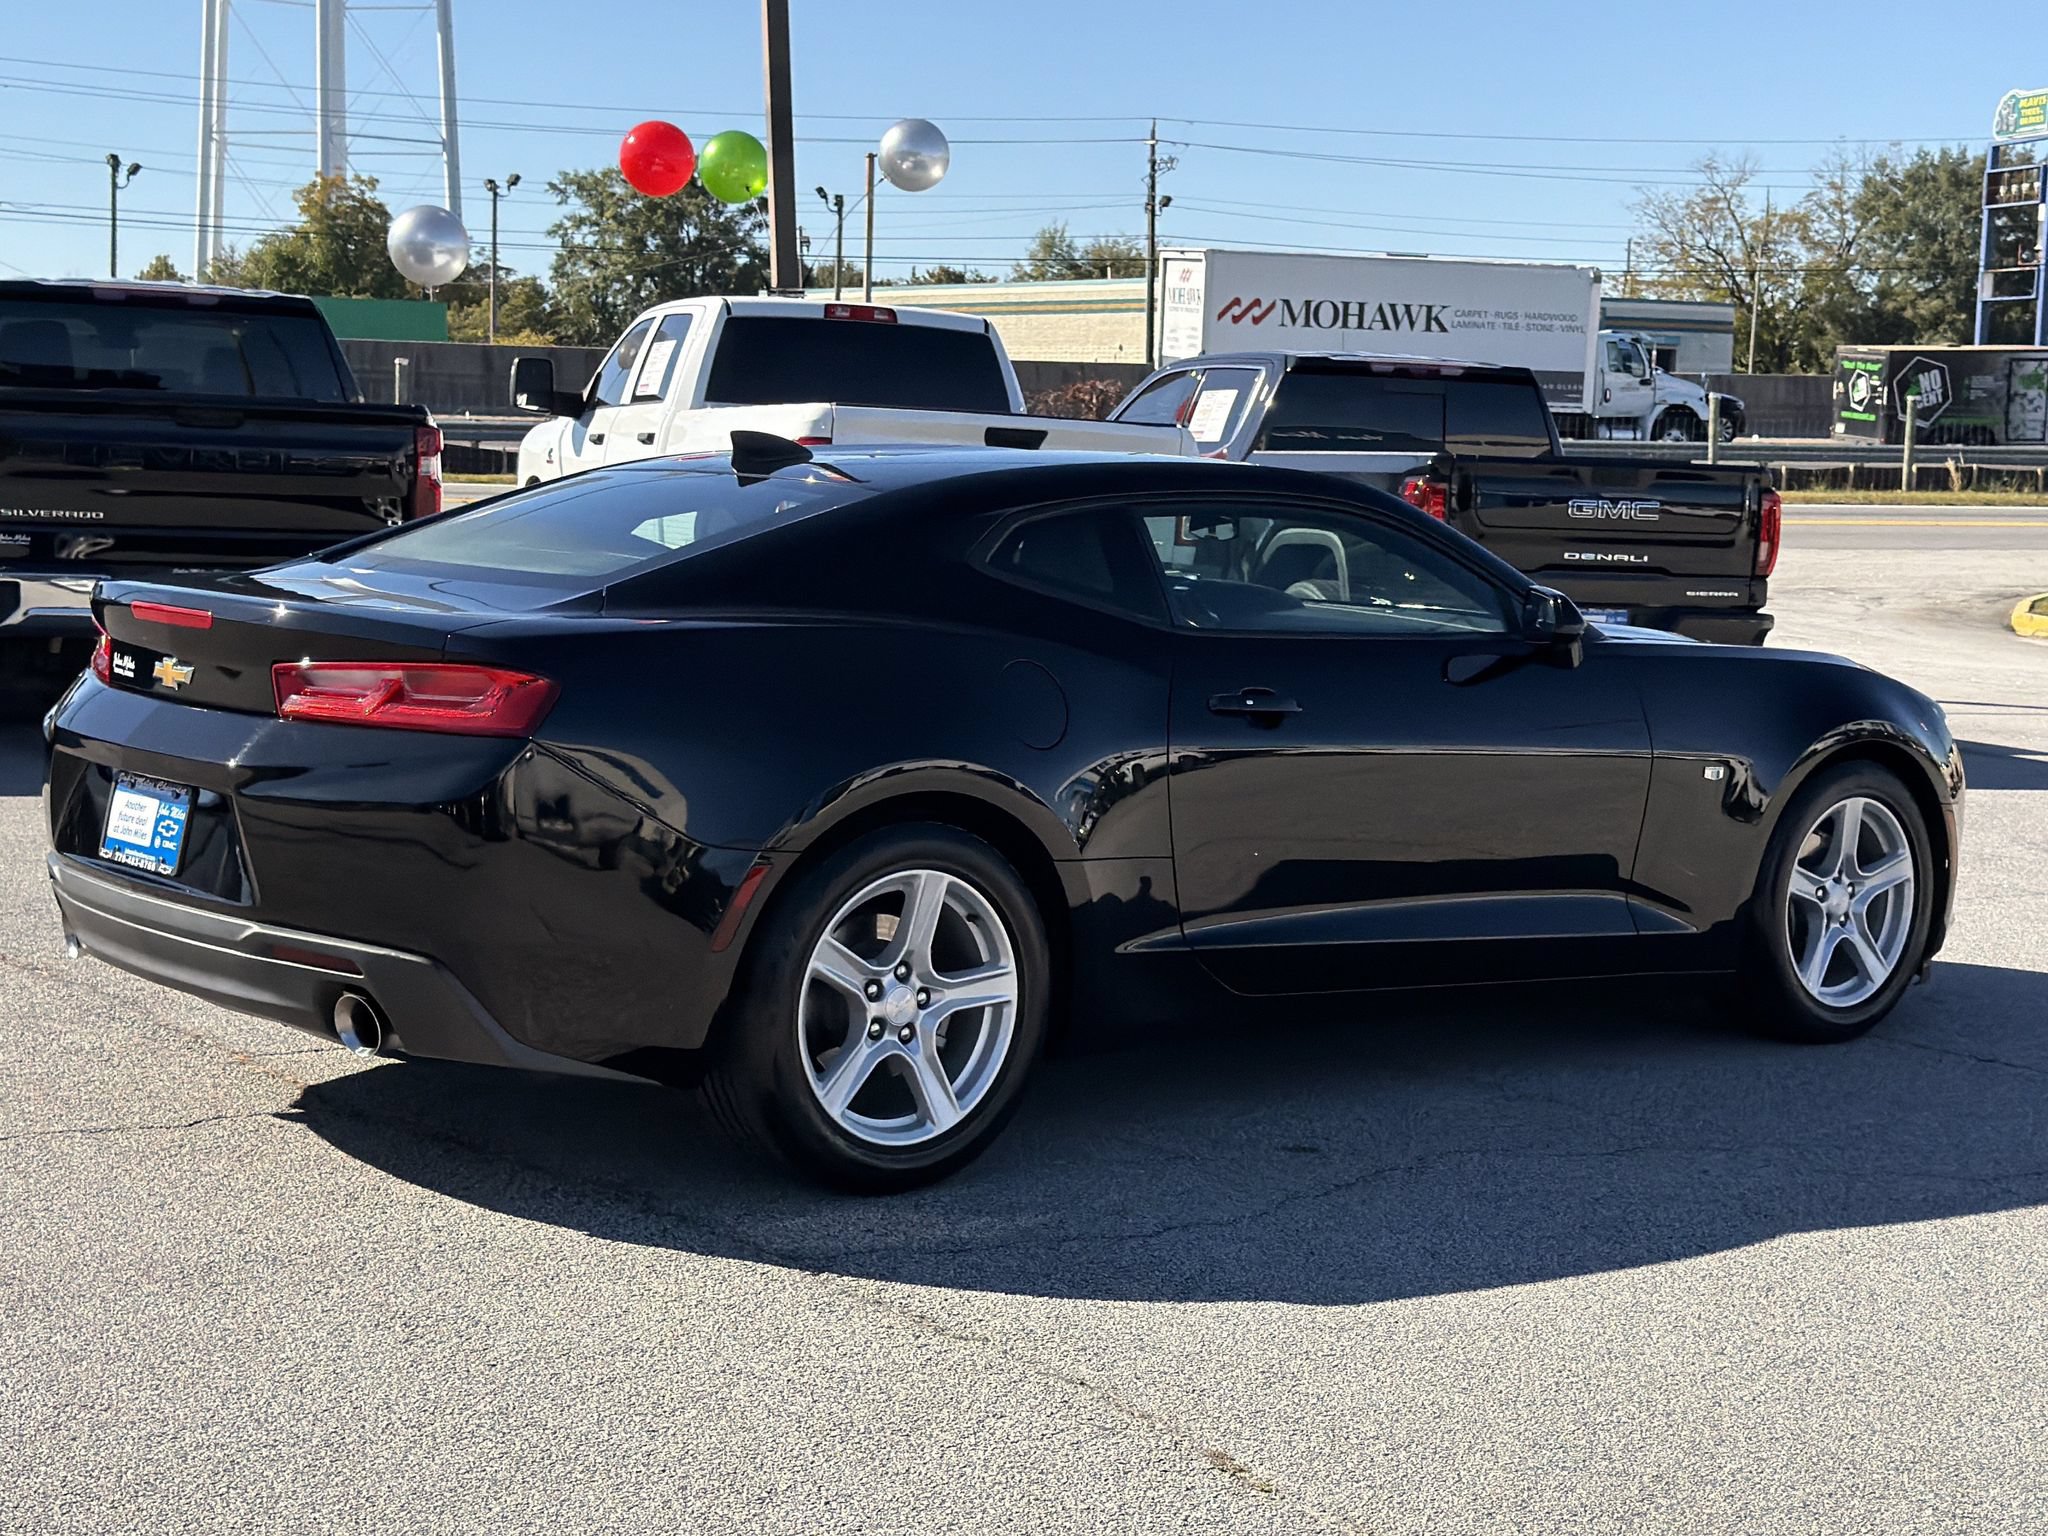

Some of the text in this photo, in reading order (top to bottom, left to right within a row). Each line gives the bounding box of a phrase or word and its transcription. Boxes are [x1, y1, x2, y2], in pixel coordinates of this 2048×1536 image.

[1279, 298, 1452, 333] MOHAWK
[1454, 309, 1579, 322] CARPET RUGS HARDWOOD
[1451, 320, 1586, 335] LAMINATE TILE STONE VINYL
[1918, 368, 1942, 394] NO
[0, 508, 104, 520] SILVERADO
[1568, 499, 1660, 521] GMC
[1563, 552, 1649, 563] DENALI
[1686, 590, 1739, 598] SIERRA
[125, 799, 148, 813] Another
[118, 811, 149, 827] future deal
[113, 825, 148, 841] at John Miles
